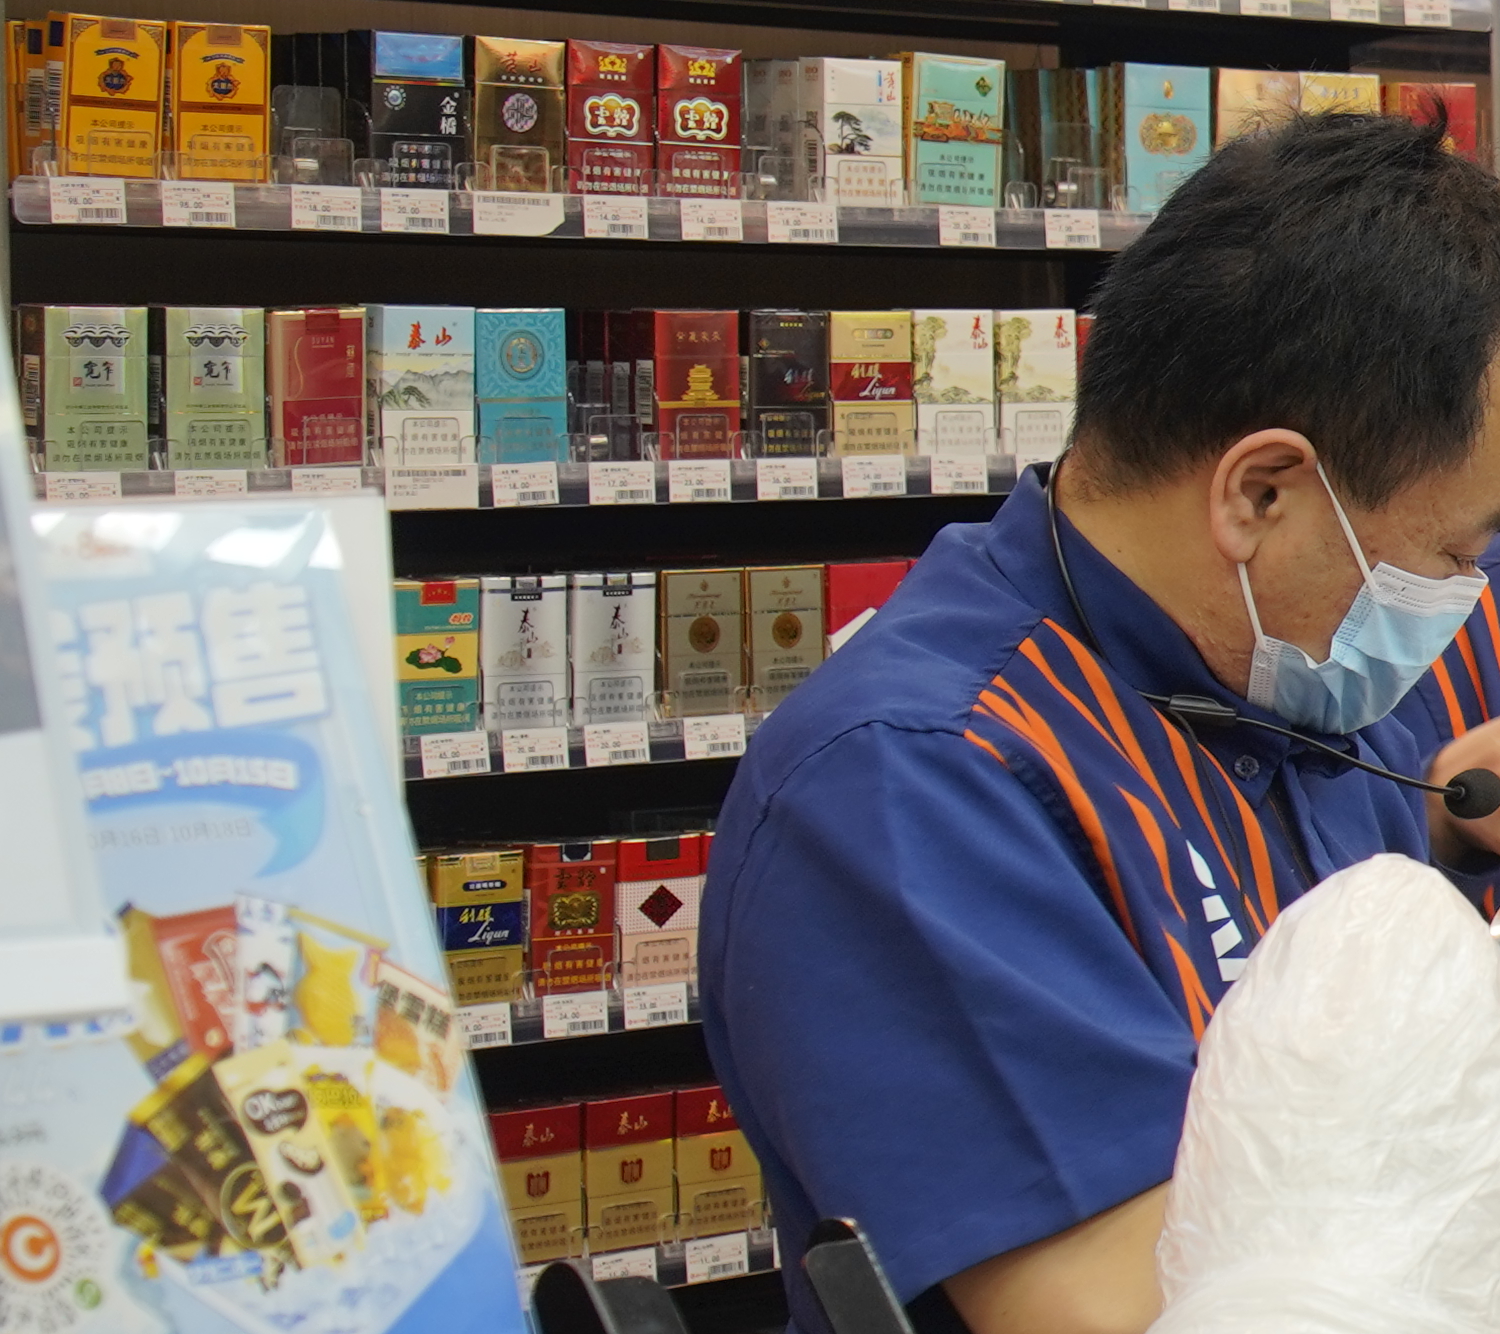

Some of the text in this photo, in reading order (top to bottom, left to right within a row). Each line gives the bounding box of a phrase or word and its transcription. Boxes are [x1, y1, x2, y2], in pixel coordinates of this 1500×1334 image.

[406, 320, 453, 350] 泰山
[66, 425, 128, 436] 本公司提示
[467, 919, 511, 944] Liqun
[522, 1122, 555, 1148] 泰山
[617, 1111, 648, 1136] 泰山
